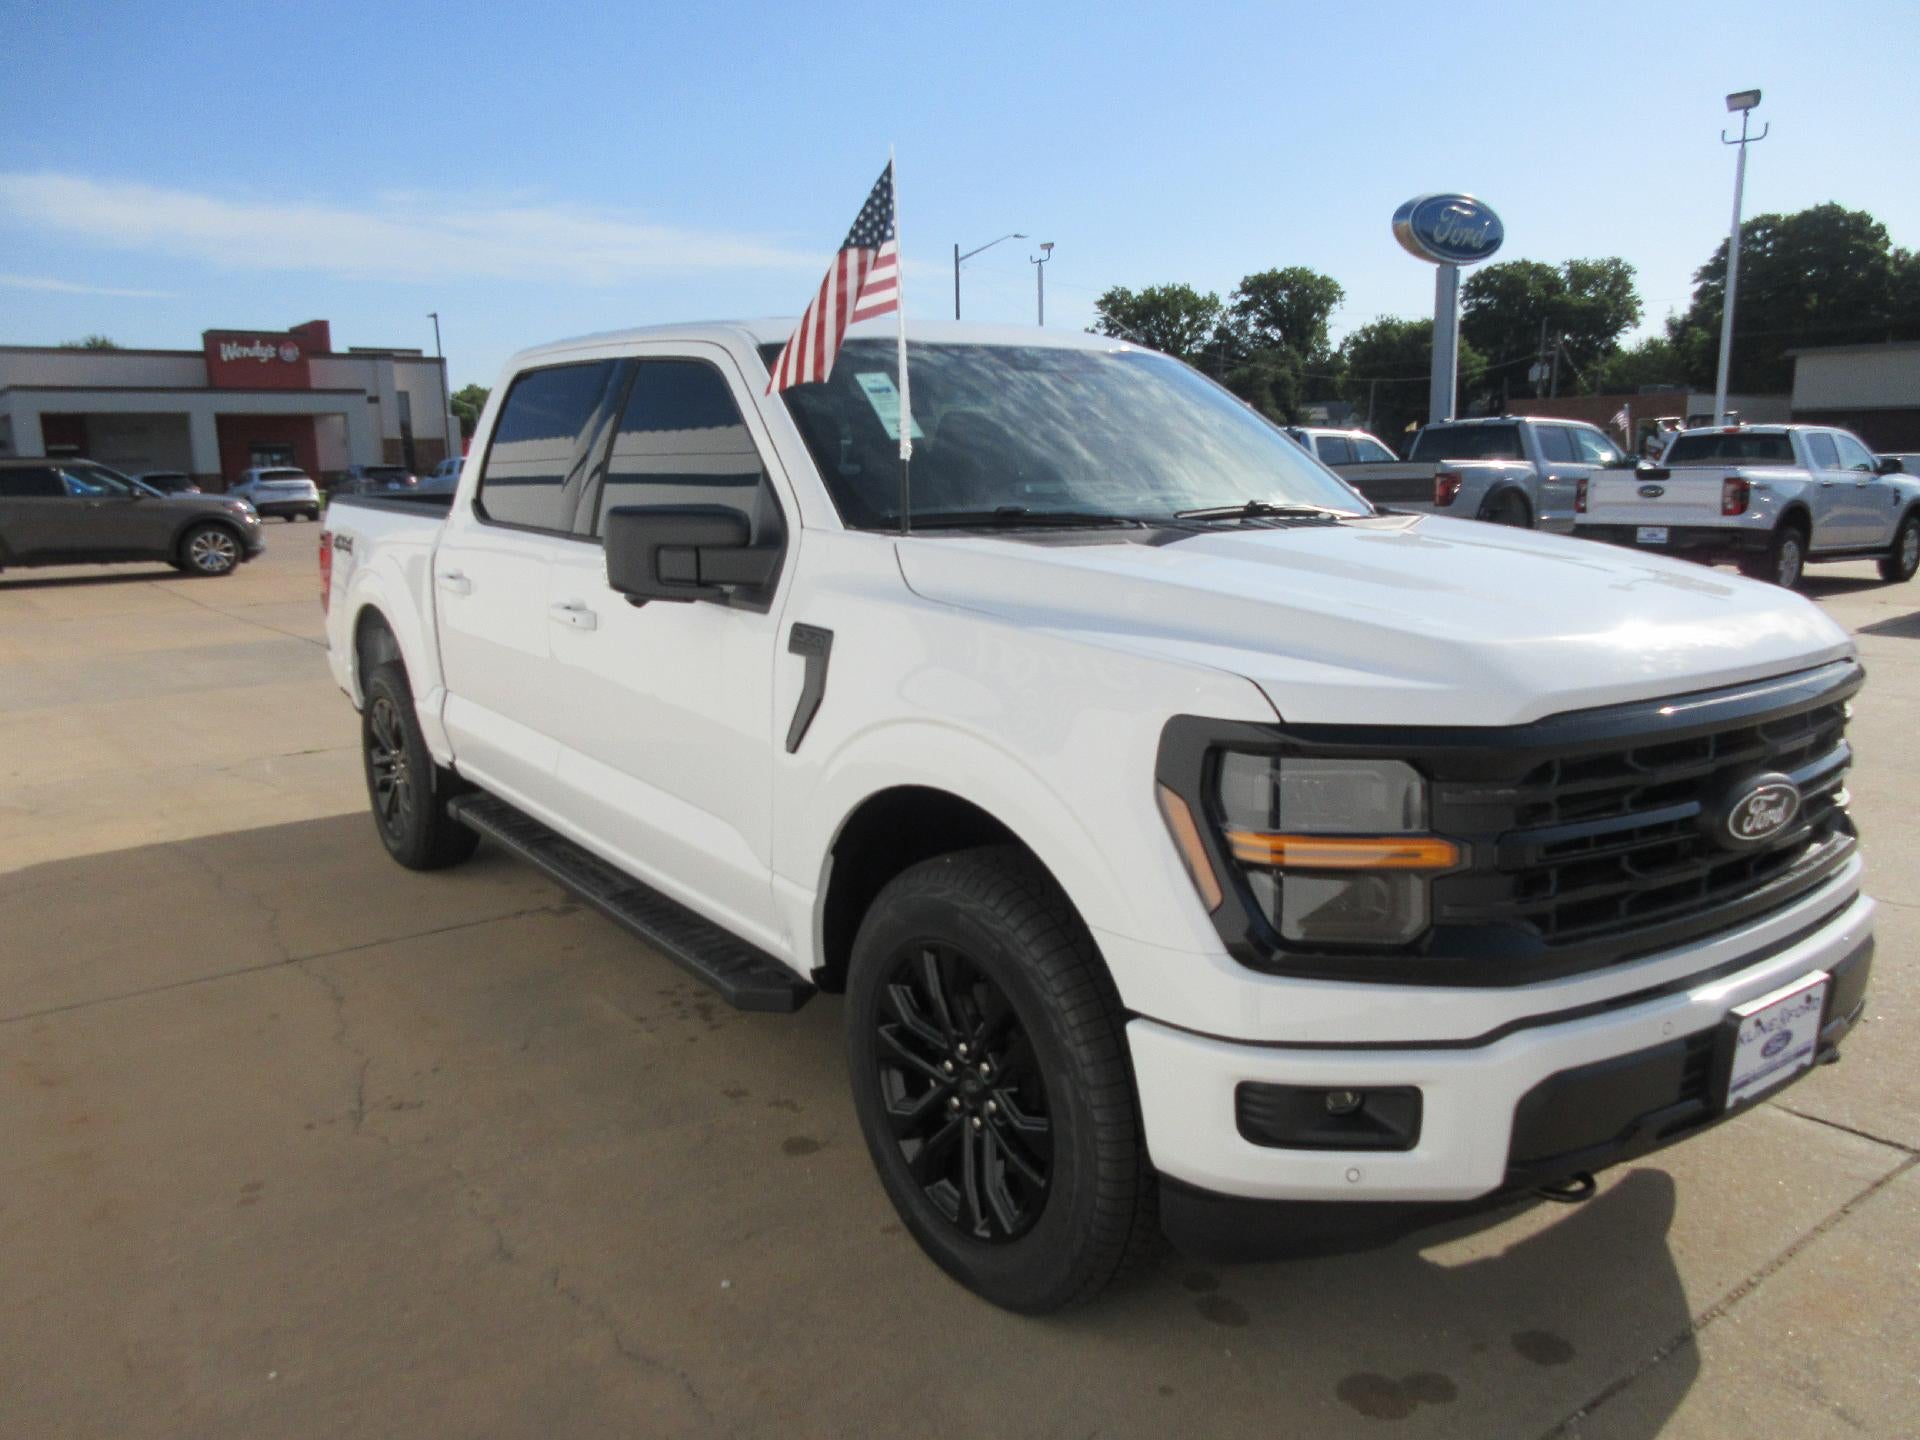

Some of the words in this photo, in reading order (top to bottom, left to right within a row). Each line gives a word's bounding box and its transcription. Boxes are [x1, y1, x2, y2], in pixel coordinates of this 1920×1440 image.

[1433, 206, 1491, 249] Ford
[220, 340, 277, 363] Wendy's
[1743, 793, 1789, 833] Ford
